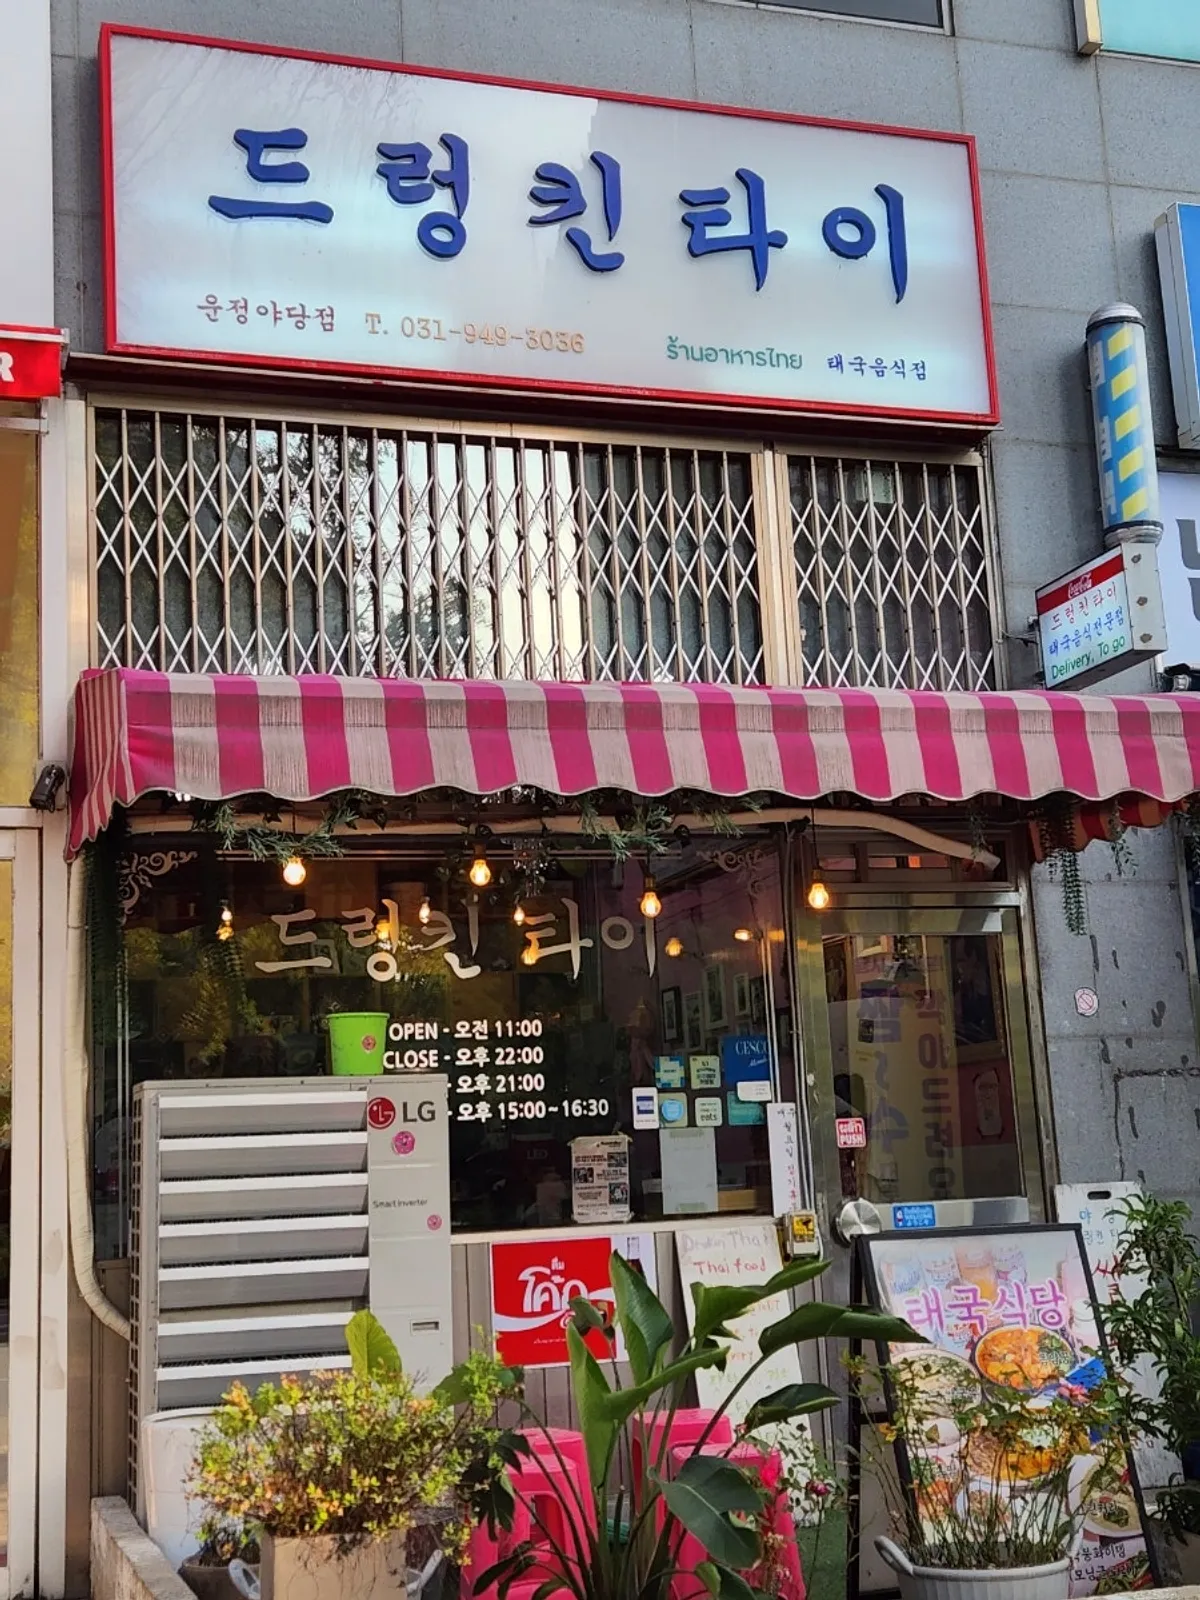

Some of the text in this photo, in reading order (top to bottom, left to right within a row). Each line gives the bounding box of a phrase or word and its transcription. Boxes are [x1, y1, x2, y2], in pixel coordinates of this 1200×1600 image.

[197, 293, 335, 333] 운정야당점
[365, 312, 585, 354] T. 031-949-3036
[666, 335, 803, 370] ร้านอาหารไทย
[827, 353, 928, 381] 태국음식점
[1097, 641, 1110, 657] To
[1112, 635, 1126, 653] go
[389, 1022, 439, 1041] OPEN
[454, 1019, 489, 1040] 오전
[495, 1019, 543, 1038] 11:00
[382, 1050, 439, 1070] CLOSE
[455, 1047, 491, 1068] 오후
[495, 1046, 544, 1066] 22:00
[456, 1073, 492, 1095] 오후
[495, 1073, 545, 1093] 21:00
[402, 1100, 436, 1123] LG
[456, 1101, 493, 1123] 오후
[693, 1256, 766, 1275] Thai food
[904, 1278, 1067, 1335] 태국식당
